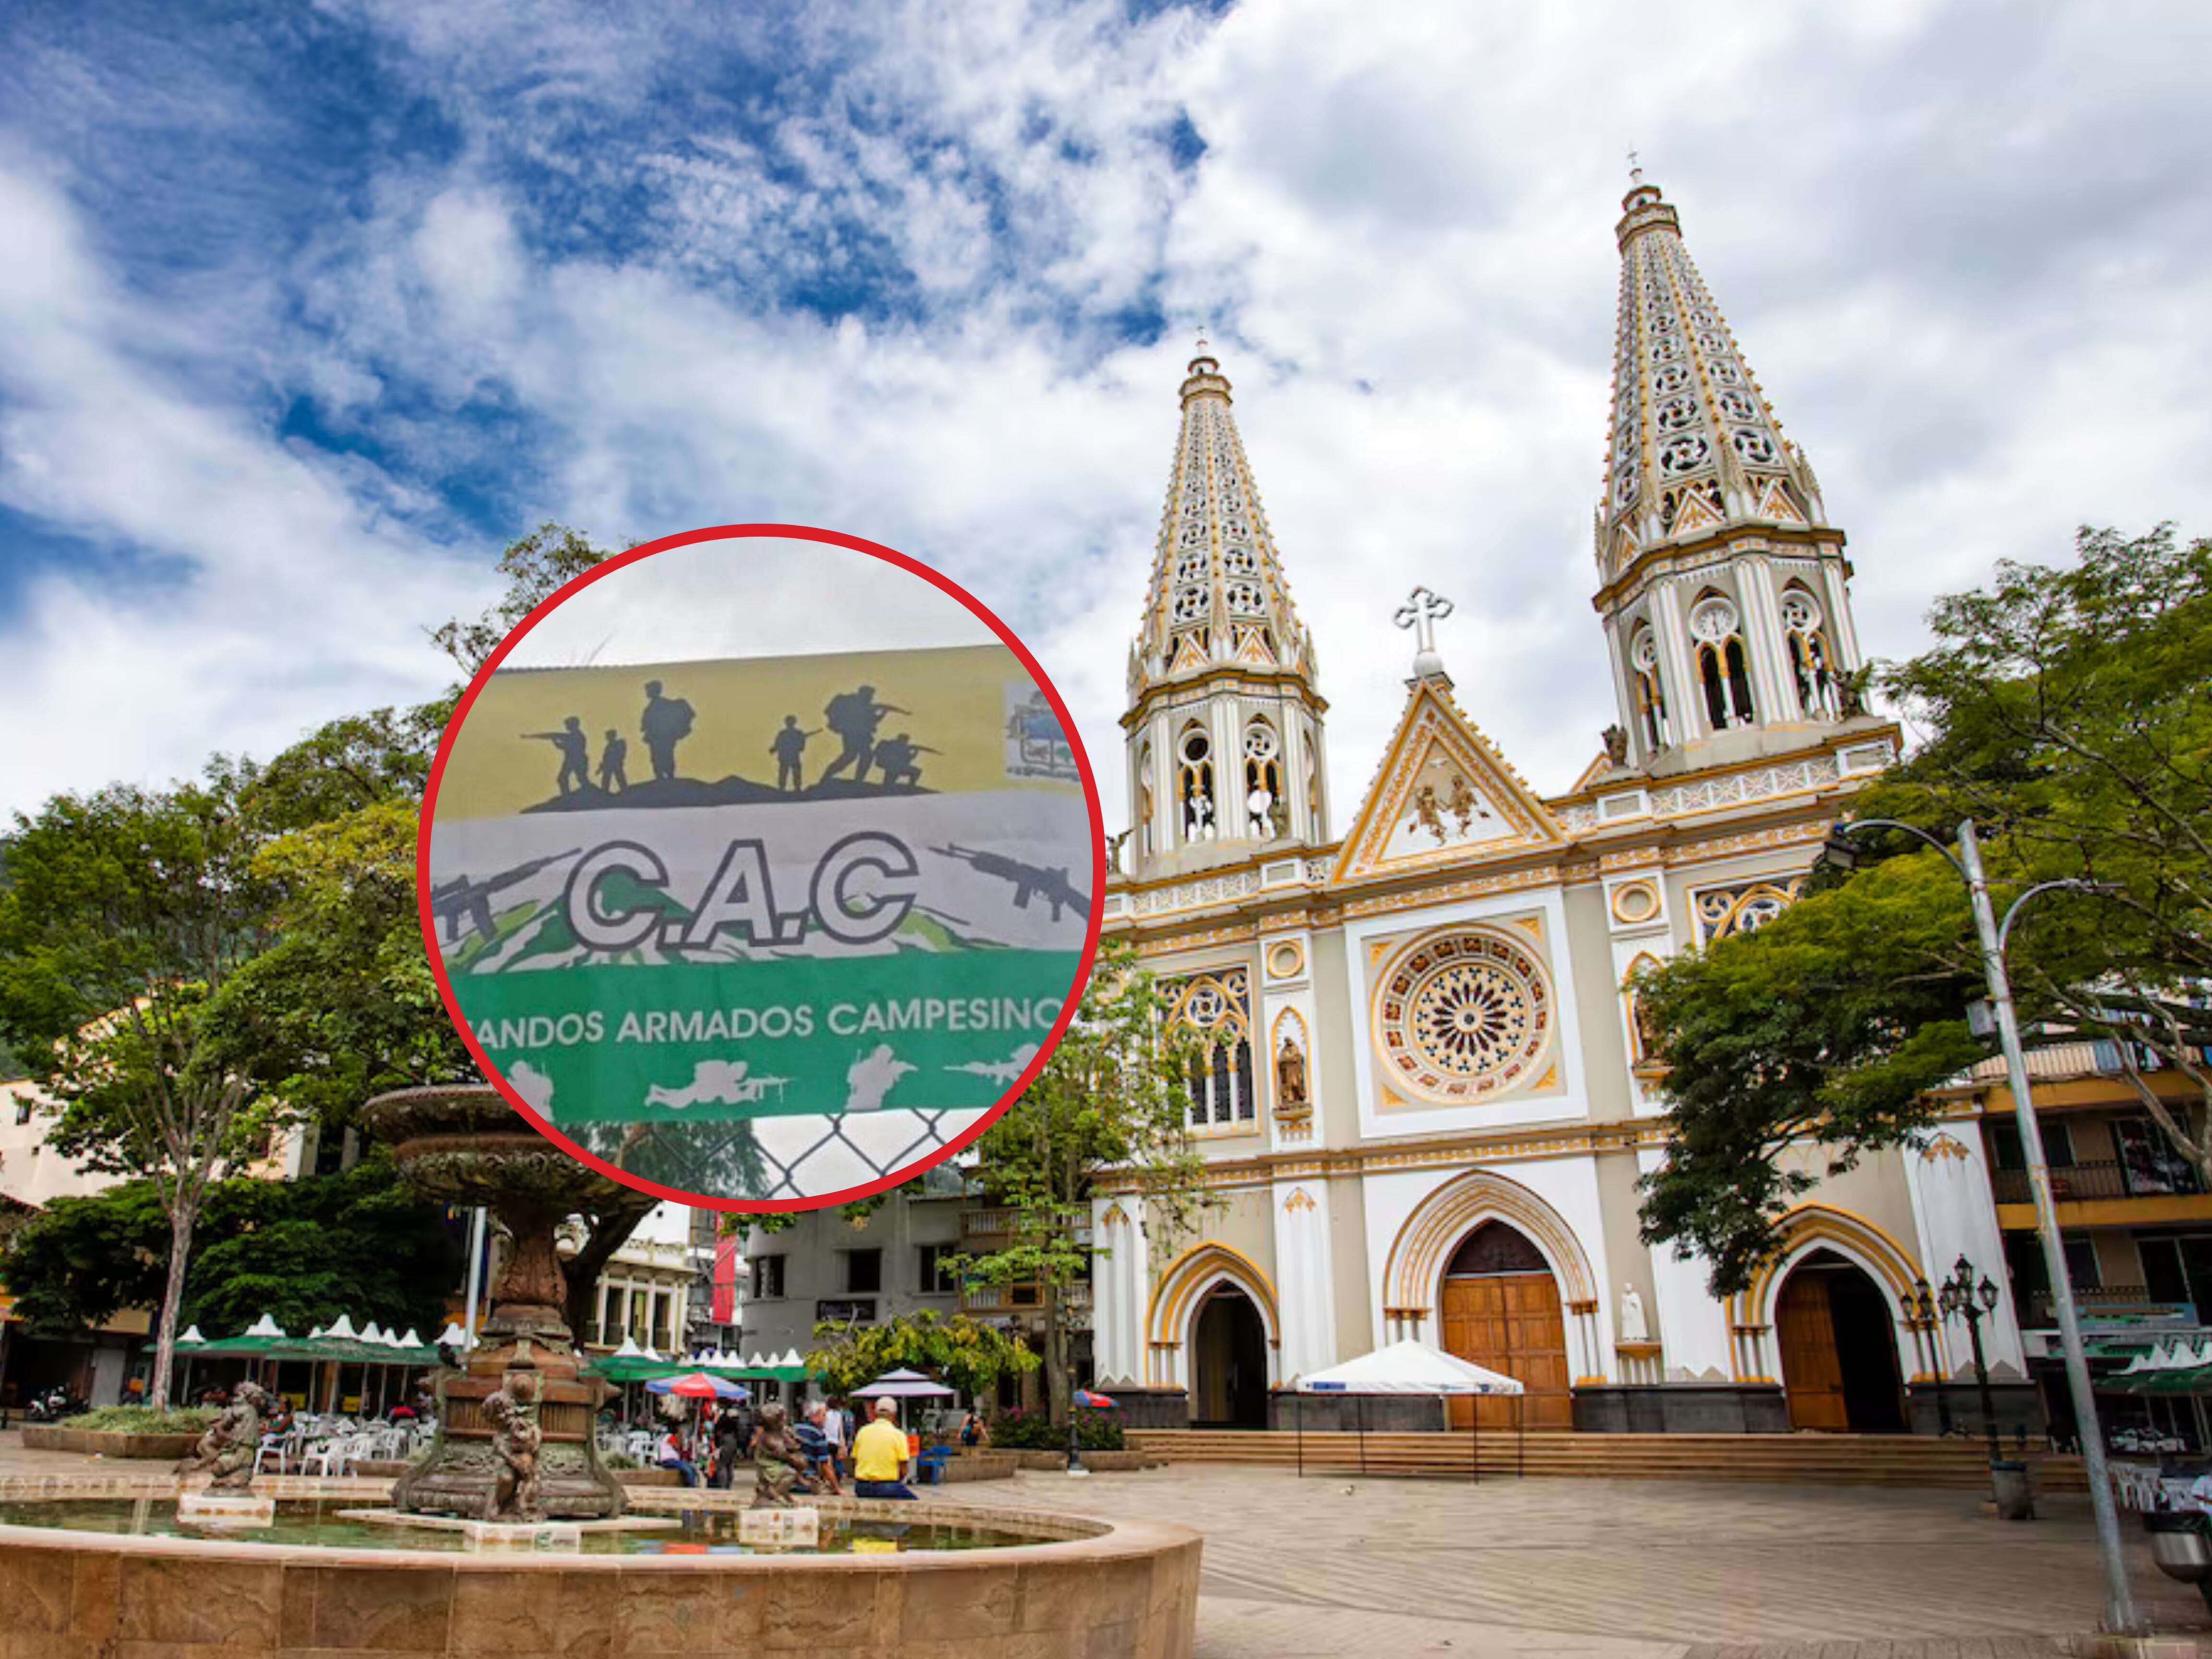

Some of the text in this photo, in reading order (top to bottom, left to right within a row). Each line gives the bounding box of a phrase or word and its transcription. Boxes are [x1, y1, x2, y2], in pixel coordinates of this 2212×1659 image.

[563, 831, 919, 952] C.A.C
[467, 997, 1064, 1049] ANDOS ARMADOS CAMPESINO
